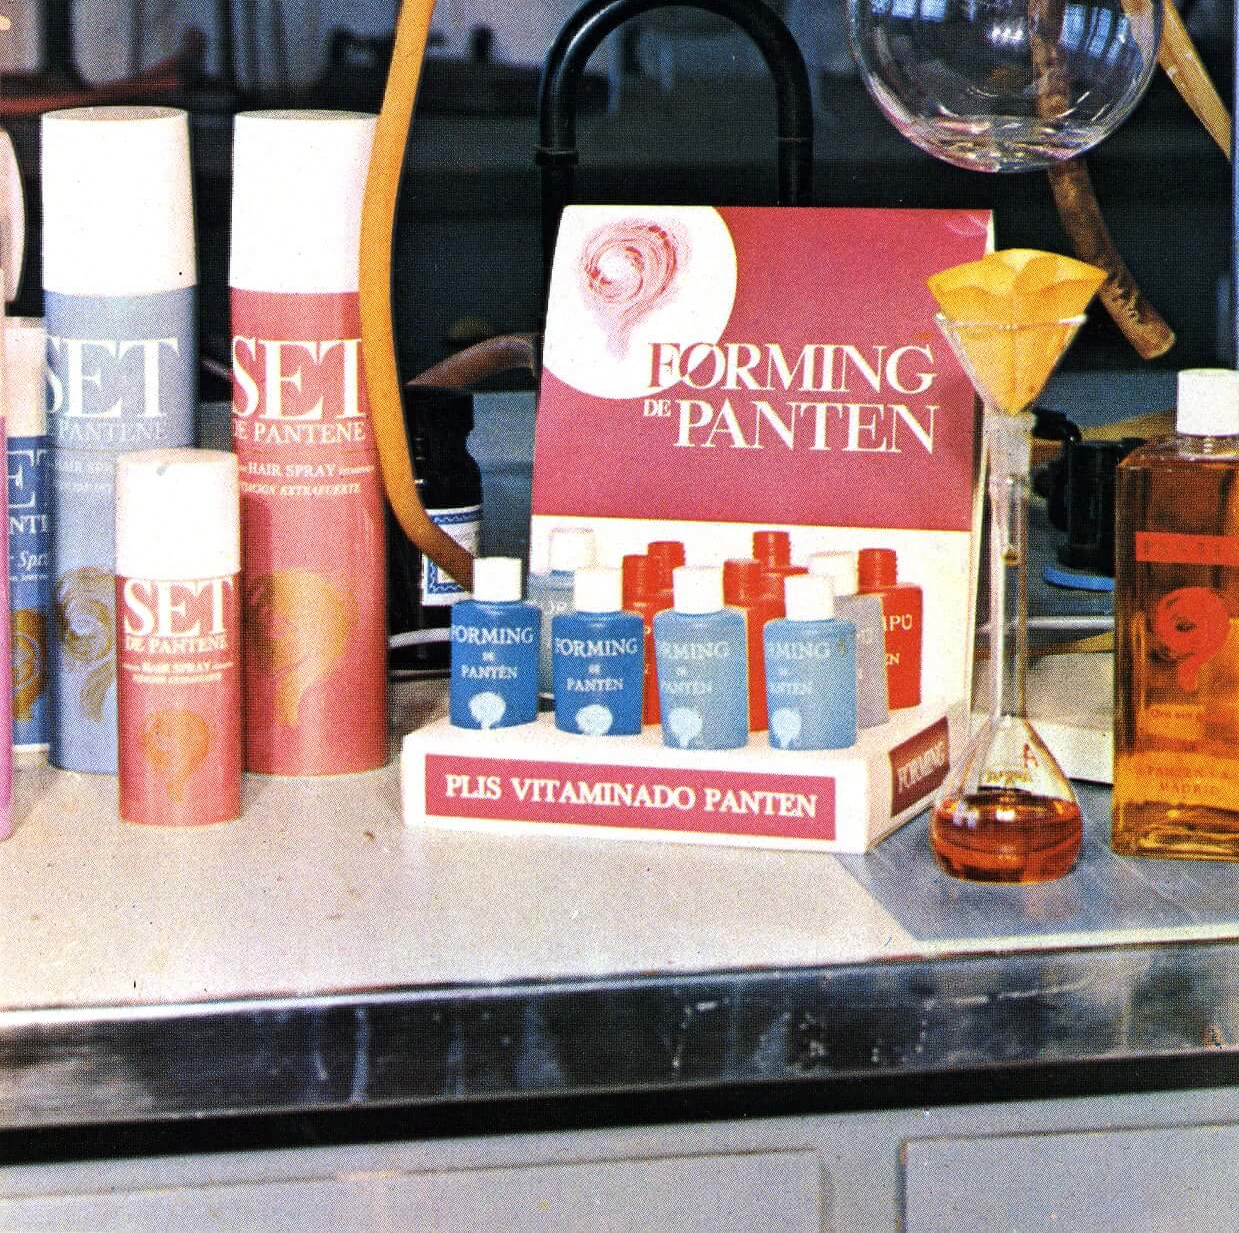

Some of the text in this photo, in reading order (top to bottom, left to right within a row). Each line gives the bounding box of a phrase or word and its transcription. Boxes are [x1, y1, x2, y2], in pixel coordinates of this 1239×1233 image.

[46, 335, 179, 420] SET
[232, 334, 367, 420] SET
[647, 341, 938, 395] FORMING
[254, 421, 366, 445] PANTENE
[642, 397, 940, 454] DE PANTEN
[248, 462, 337, 479] HAIR SPRAY
[123, 577, 234, 638] SET
[445, 773, 818, 819] PLIS VITAMINADO PANTEN
